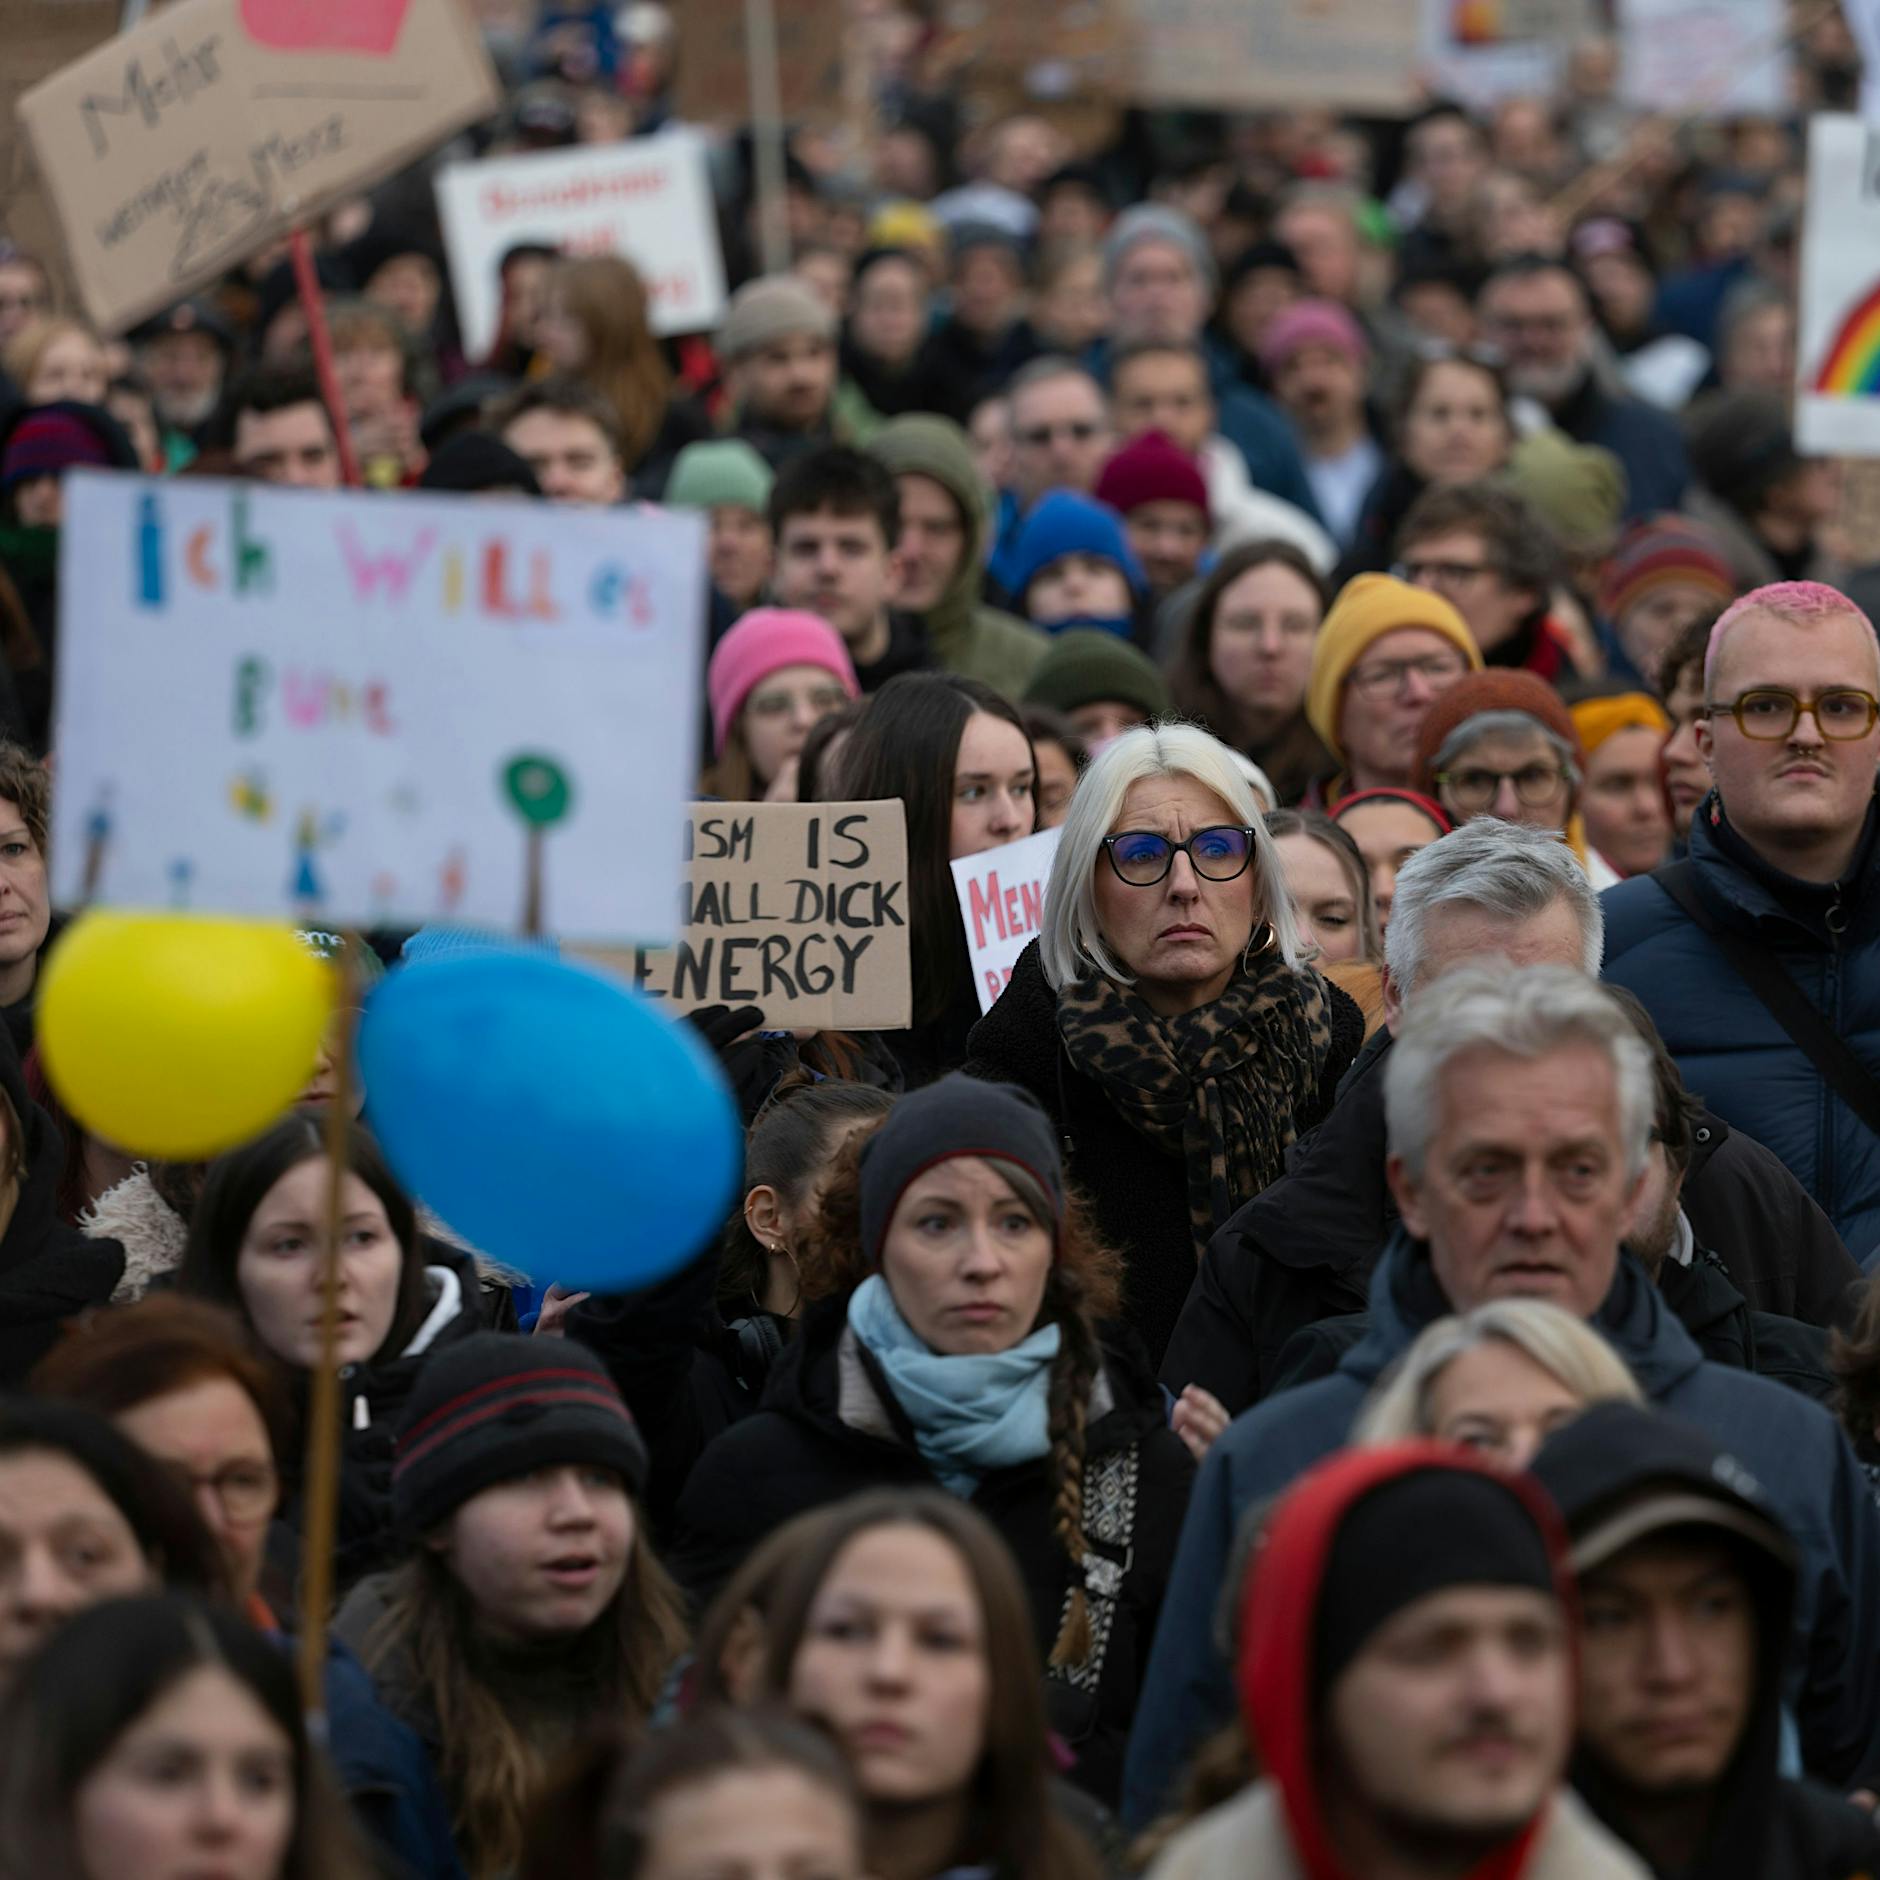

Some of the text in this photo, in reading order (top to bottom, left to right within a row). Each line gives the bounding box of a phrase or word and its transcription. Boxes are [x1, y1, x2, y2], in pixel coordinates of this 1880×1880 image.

[80, 34, 222, 160] Mehr
[248, 110, 345, 192] Merz
[134, 484, 277, 612] Ich
[683, 814, 869, 869] ISM IS
[680, 878, 904, 928] ALL DICK
[633, 934, 873, 1000] ENERGY
